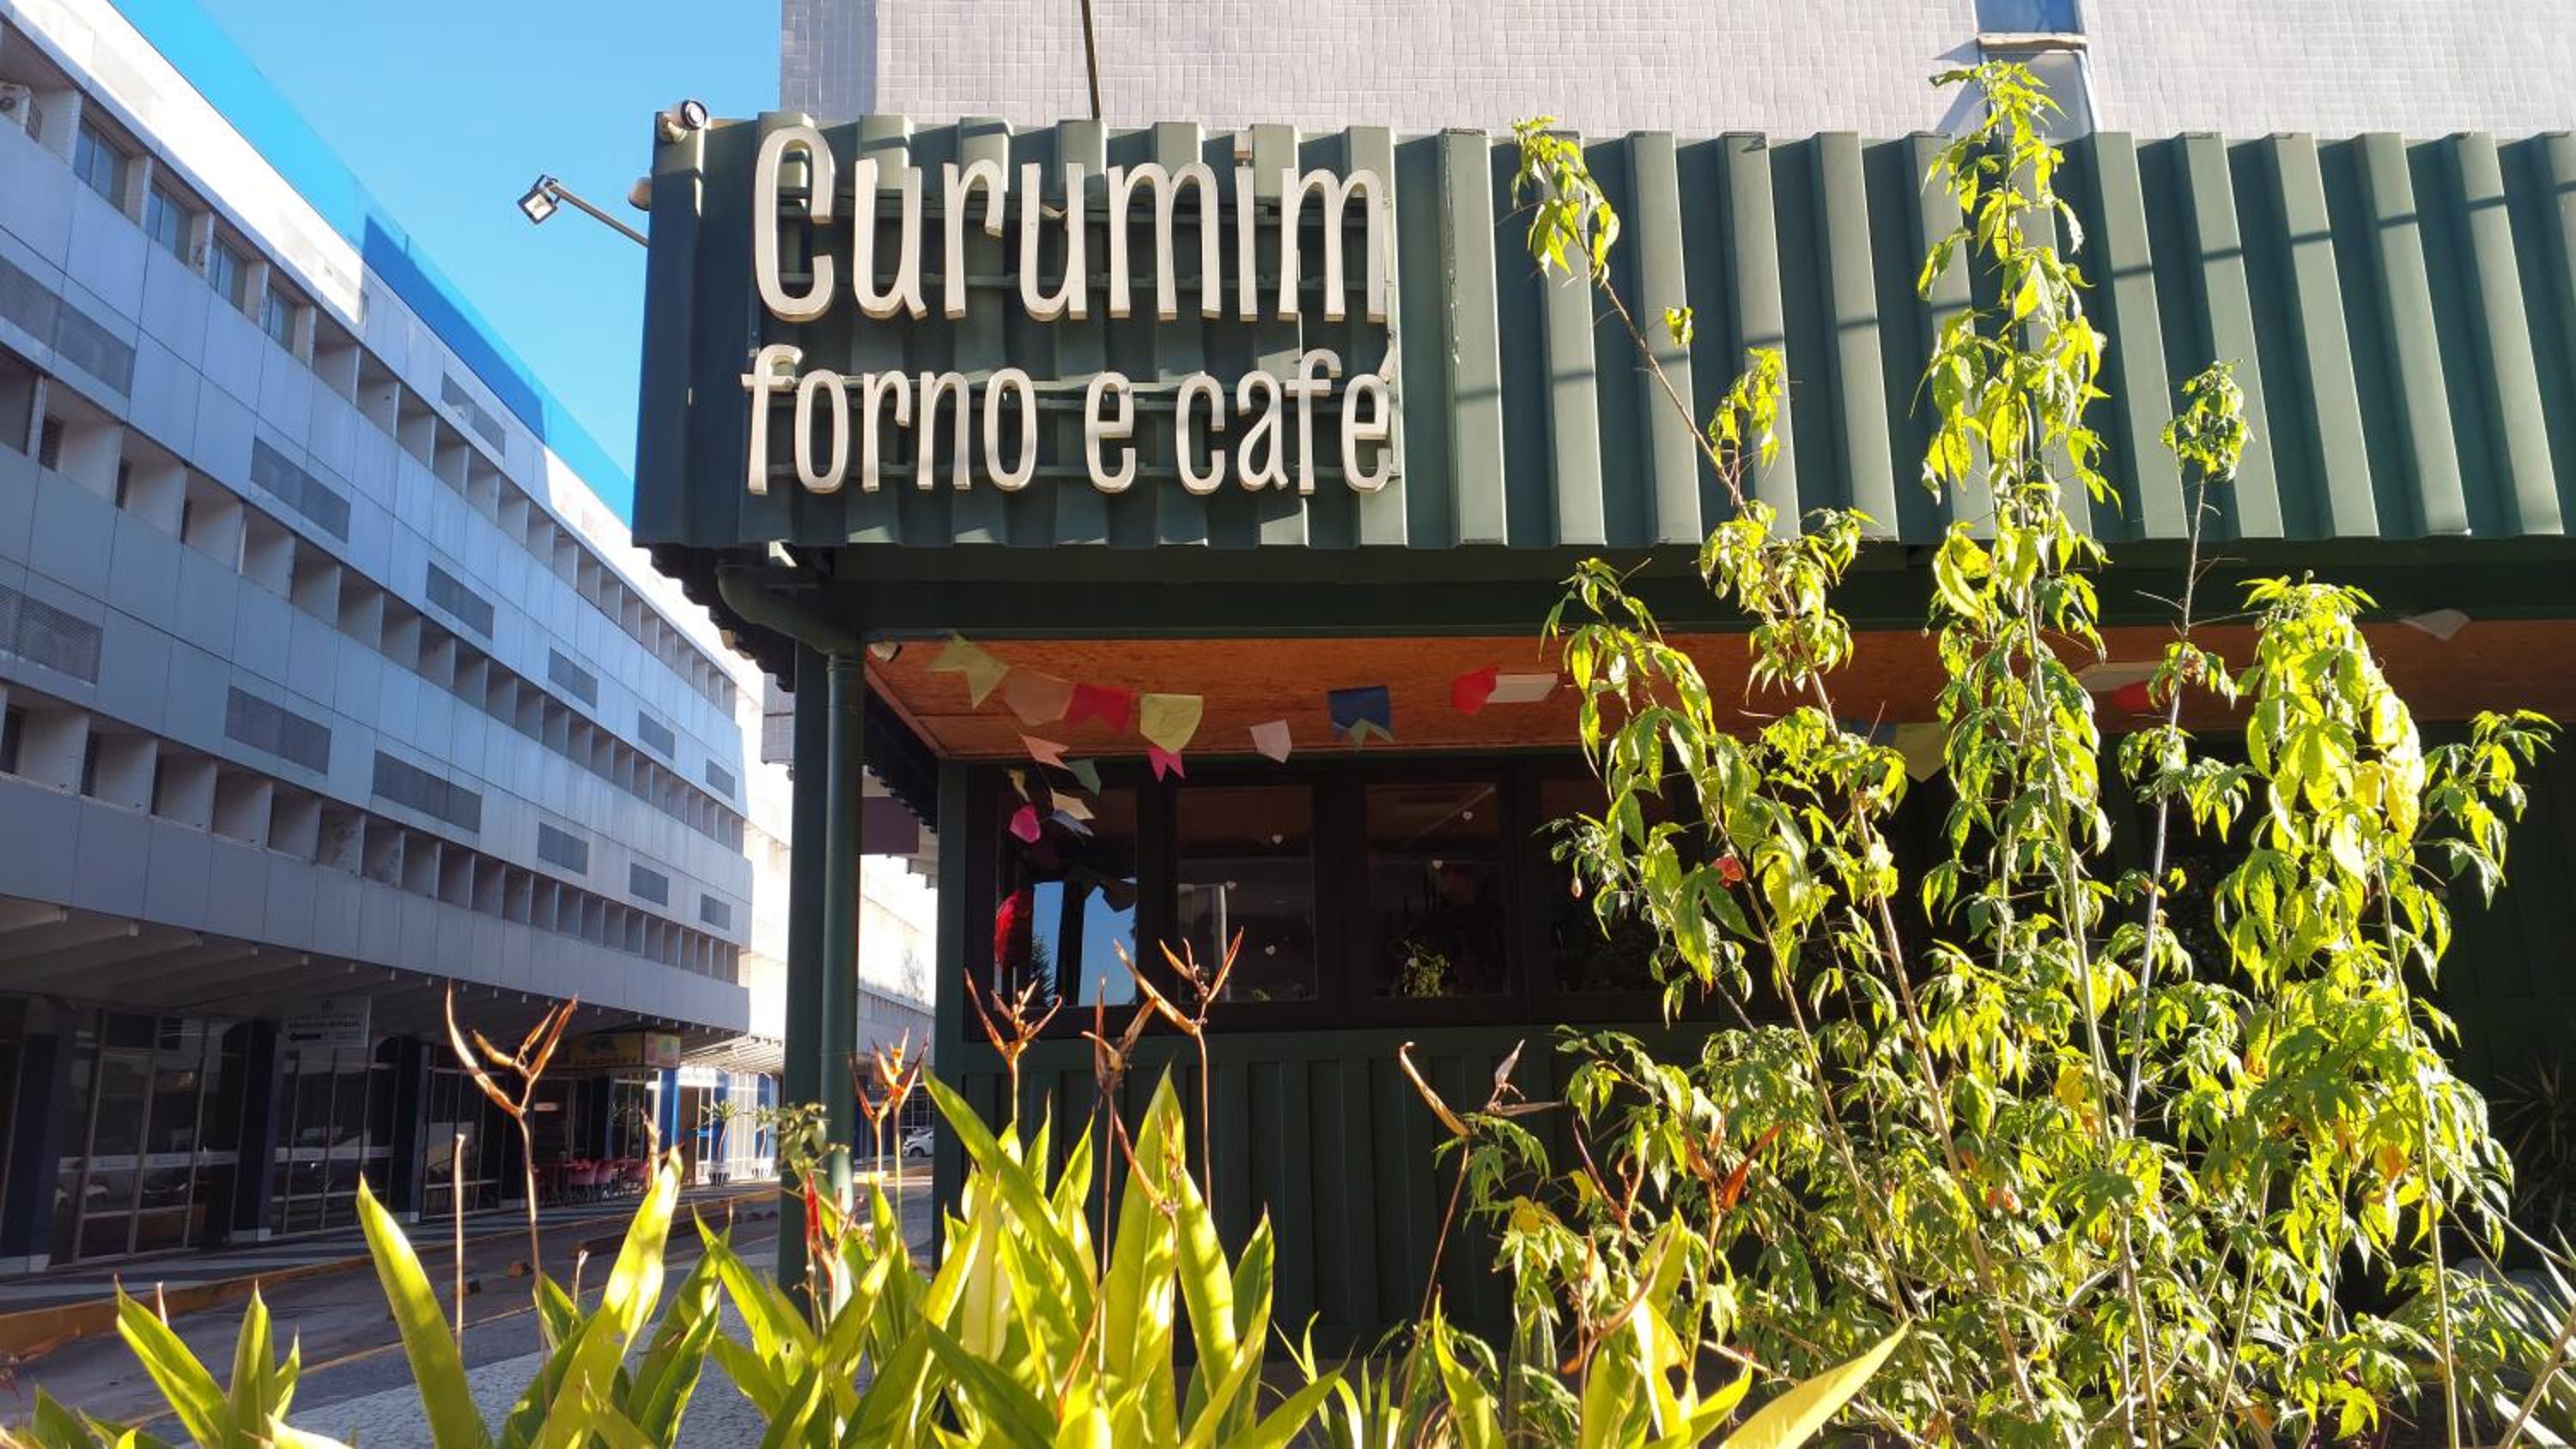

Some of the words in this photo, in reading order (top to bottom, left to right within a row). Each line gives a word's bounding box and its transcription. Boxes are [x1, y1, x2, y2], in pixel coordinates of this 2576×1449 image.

[755, 125, 1388, 324] Curumim
[741, 343, 1038, 495] forno
[1084, 371, 1136, 494] e
